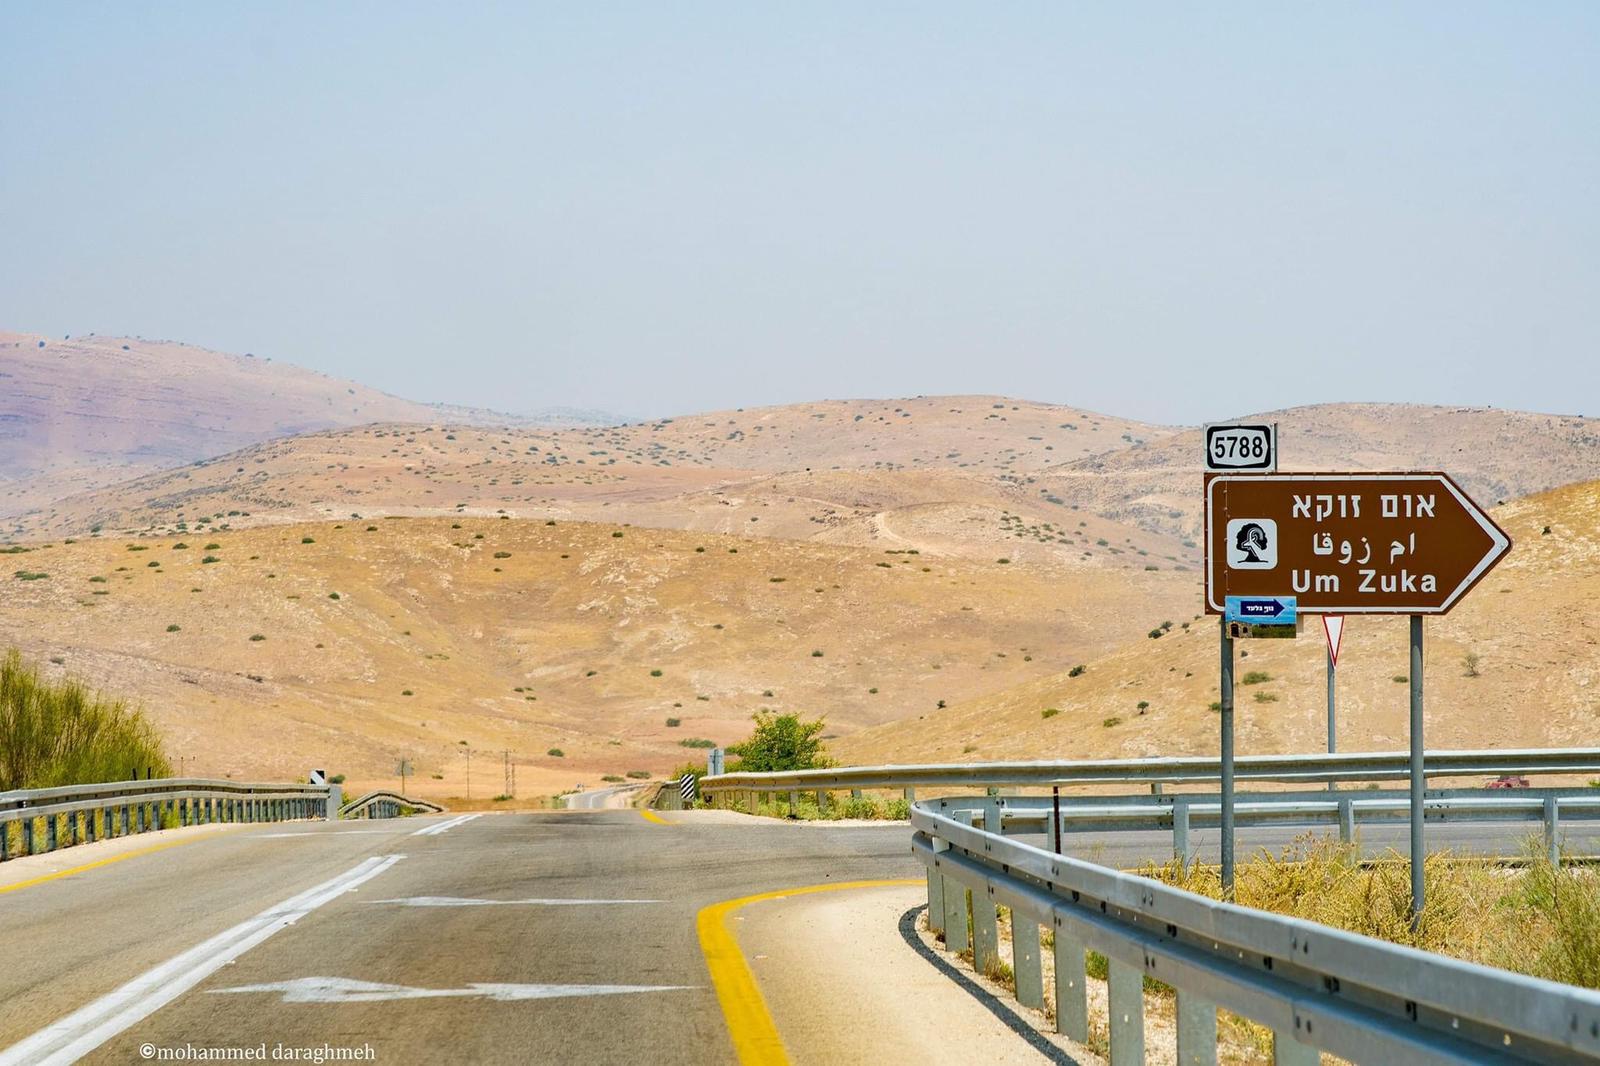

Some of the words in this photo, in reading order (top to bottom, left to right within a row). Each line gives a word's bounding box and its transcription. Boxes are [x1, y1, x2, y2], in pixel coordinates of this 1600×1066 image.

[1214, 436, 1264, 459] 5788
[1292, 494, 1361, 522] זוקא
[1380, 494, 1436, 518] אום
[1313, 532, 1371, 565] زوقا
[1390, 532, 1415, 565] ام
[1292, 569, 1340, 593] Um
[1358, 569, 1437, 593] Zuka
